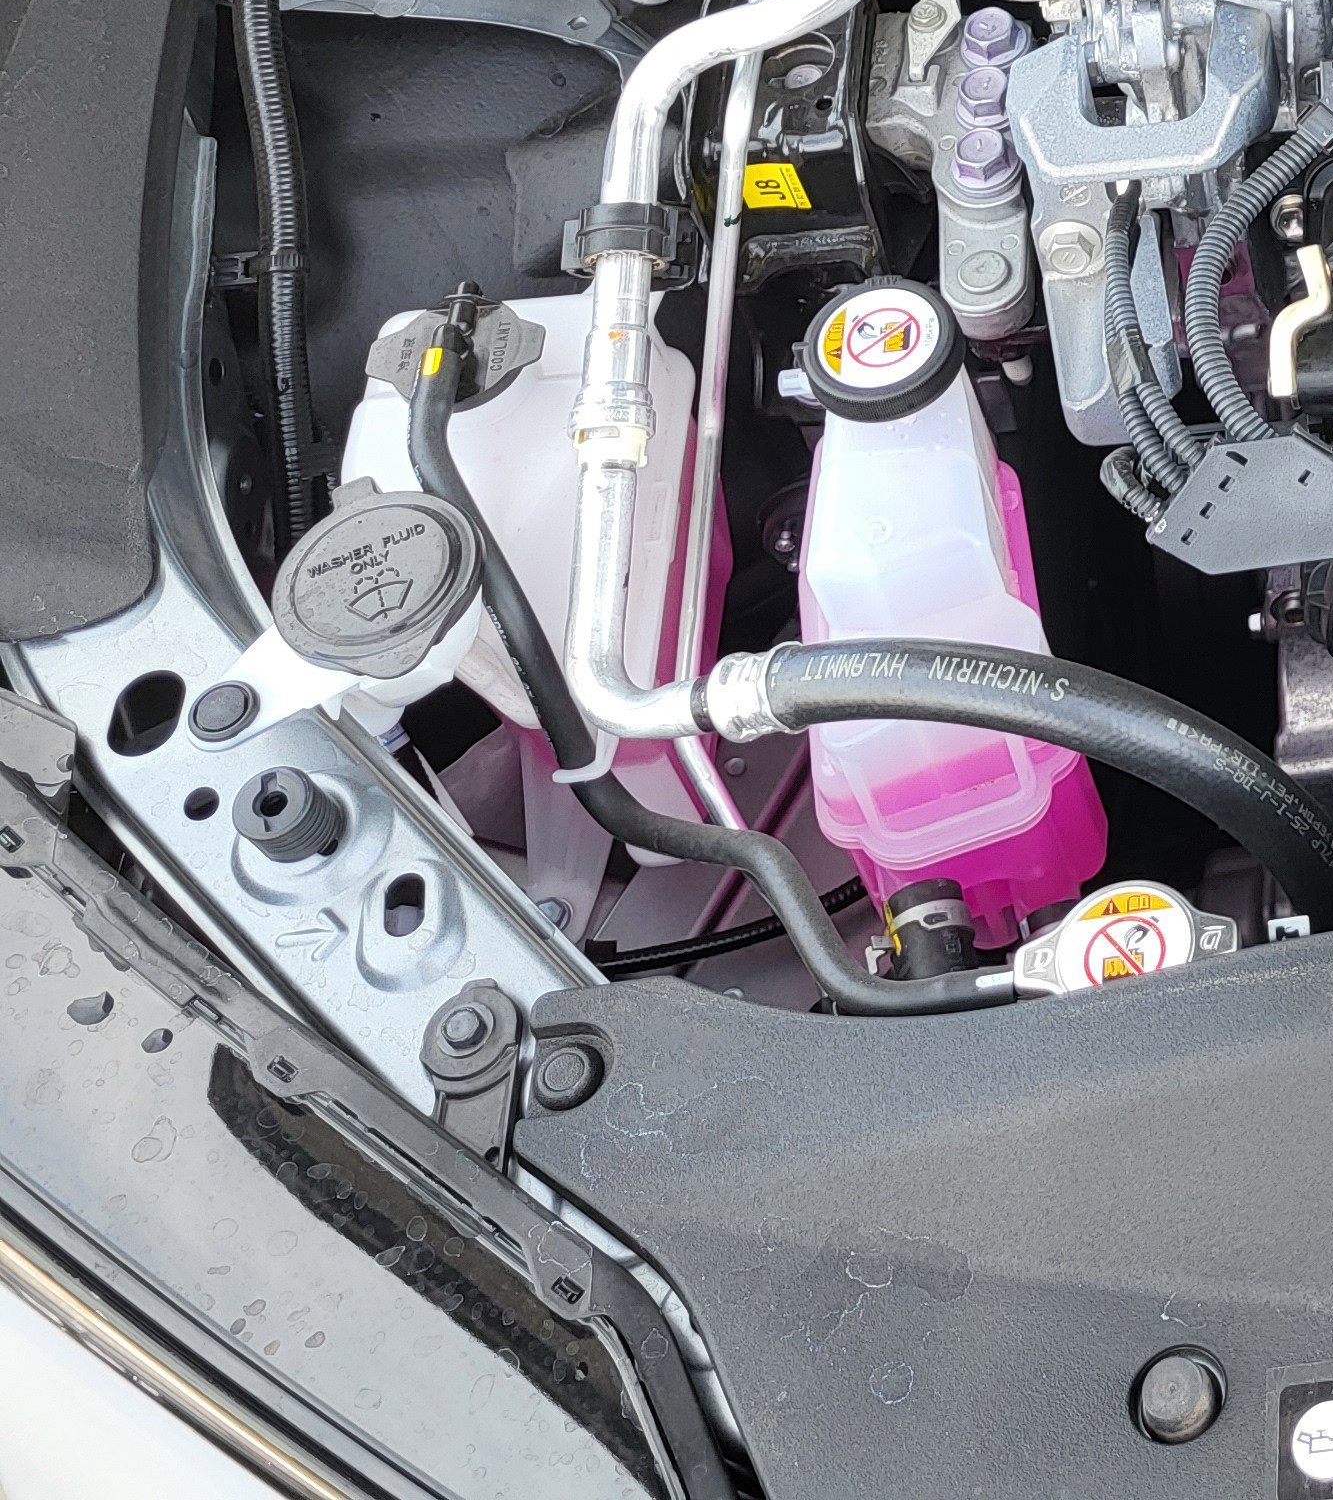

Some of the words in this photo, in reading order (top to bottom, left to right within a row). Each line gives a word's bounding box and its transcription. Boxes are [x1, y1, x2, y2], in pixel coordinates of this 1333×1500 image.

[754, 179, 787, 201] J8
[489, 321, 512, 372] COOLANT
[306, 543, 375, 579] WASHER
[382, 522, 426, 549] FLUID
[349, 549, 390, 575] ONLY
